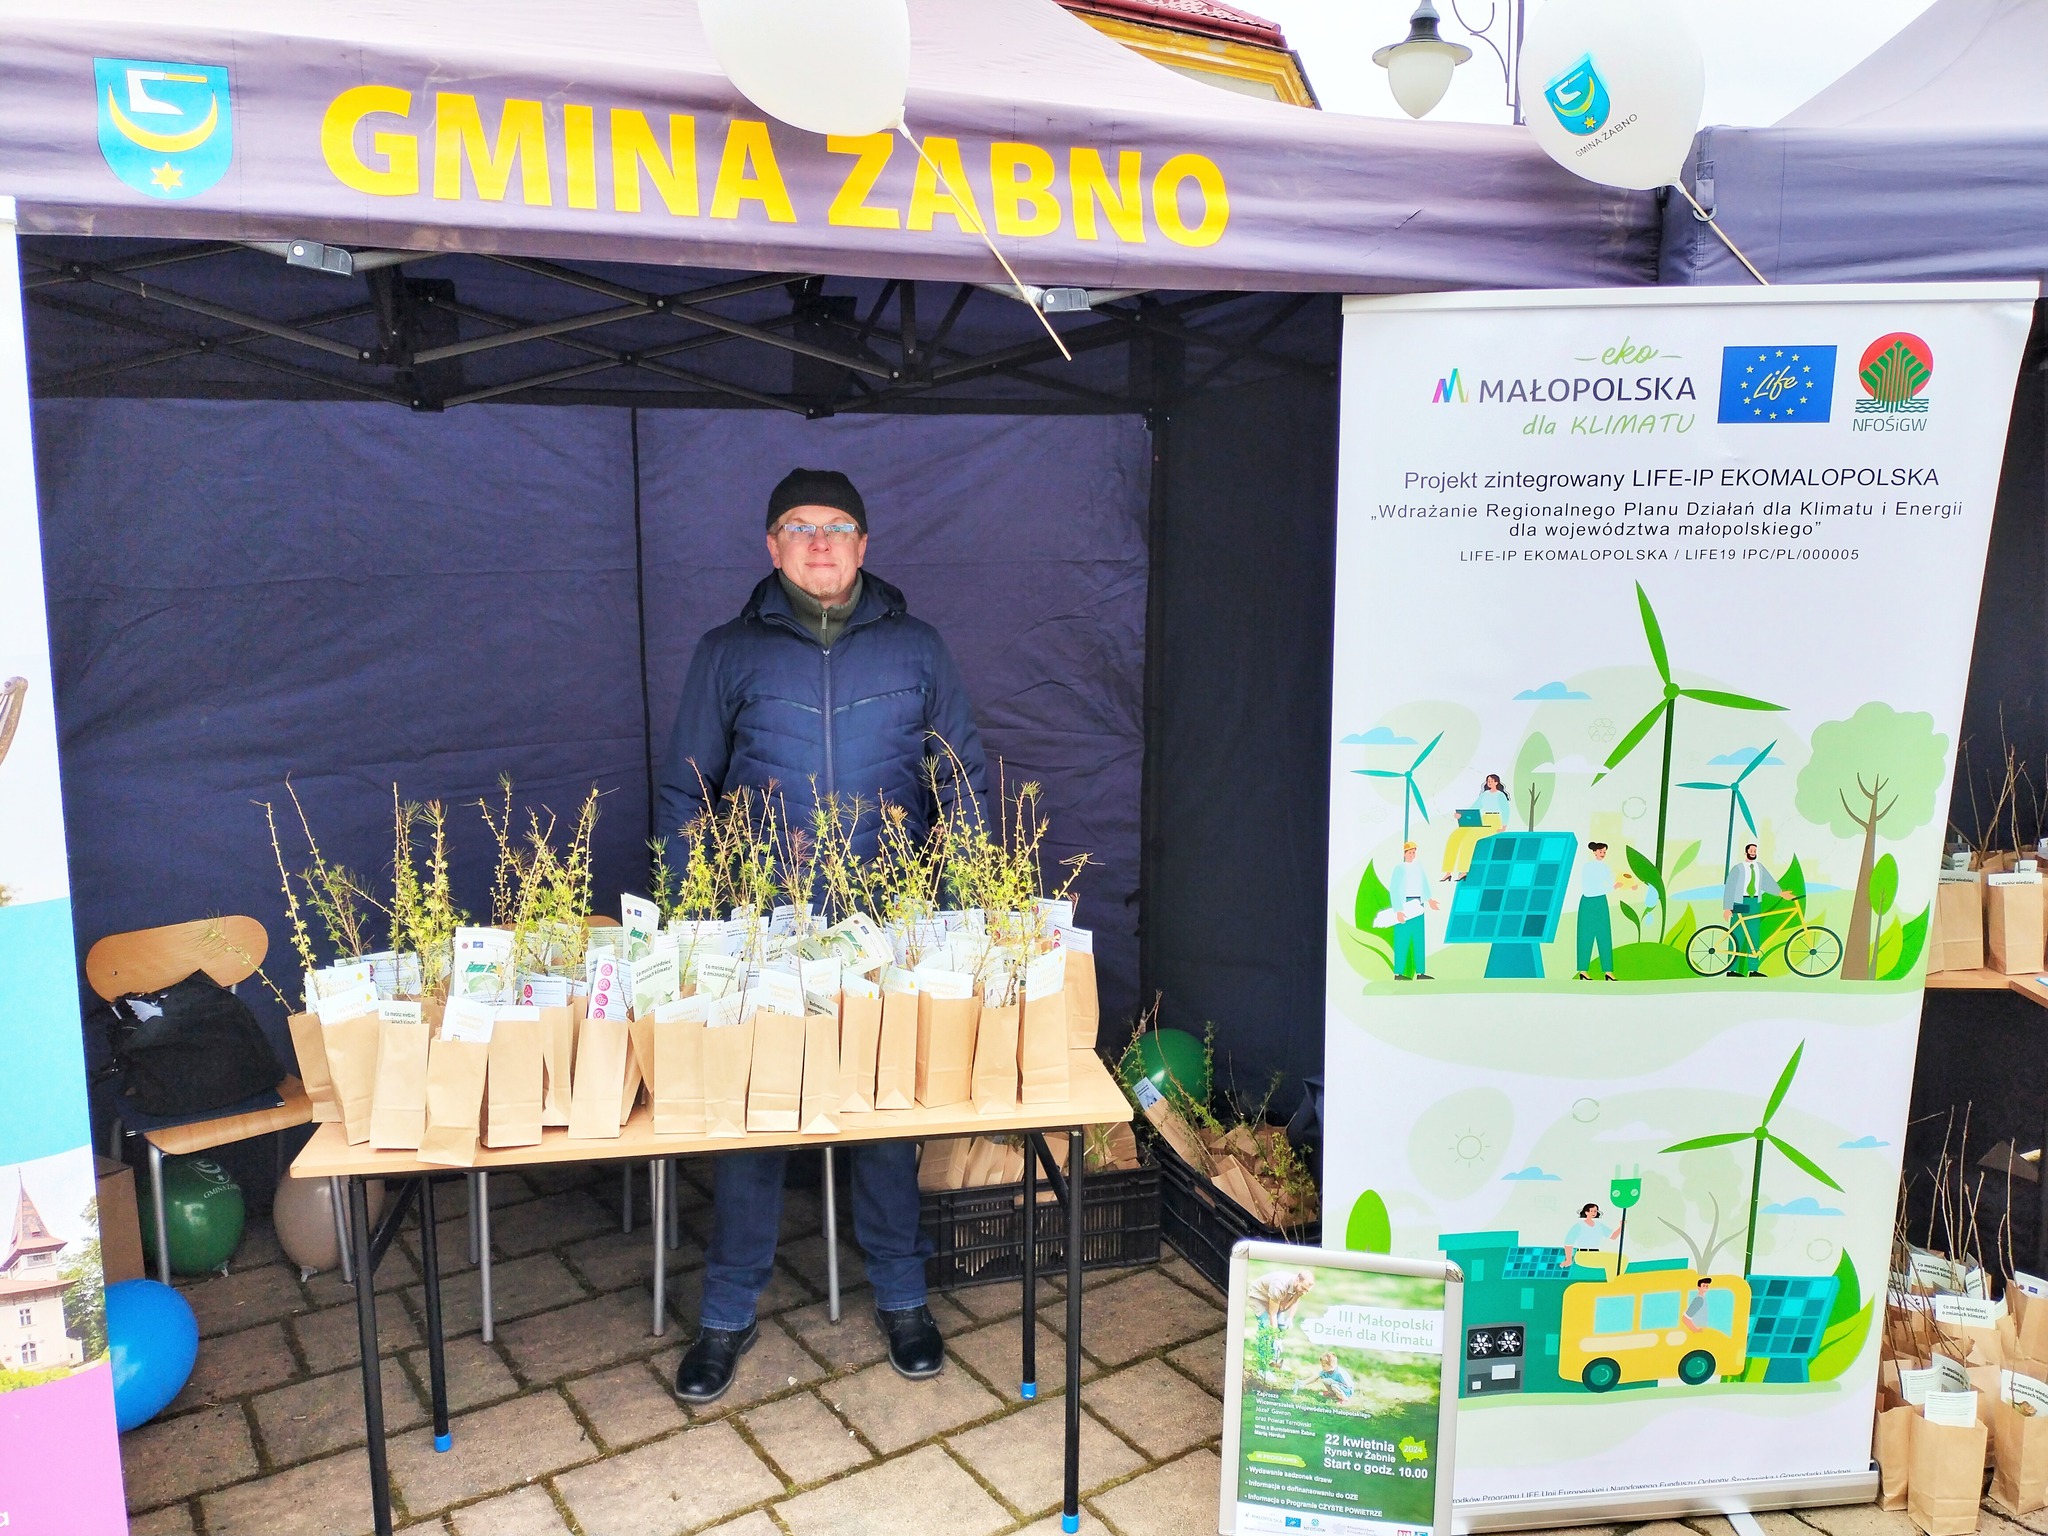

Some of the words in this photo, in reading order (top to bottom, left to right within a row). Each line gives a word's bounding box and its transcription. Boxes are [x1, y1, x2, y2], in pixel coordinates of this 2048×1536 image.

[1575, 138, 1603, 157] GMINA
[1602, 113, 1638, 141] ŻABNO
[320, 83, 797, 223] GMINA
[1601, 336, 1659, 365] eko
[1479, 376, 1697, 403] MAŁOPOLSKA
[1753, 365, 1798, 401] Life
[1523, 414, 1556, 435] dla
[1571, 413, 1696, 435] KLIMATU
[1852, 415, 1928, 432] NFOŚiGW
[1404, 471, 1478, 493] Projekt
[1484, 471, 1625, 492] zintegrowany
[1633, 469, 1714, 487] LIFE-IP
[1721, 468, 1940, 487] EKOMALOPOLSKA
[1371, 503, 1478, 521] „Wdrażanie
[1486, 503, 1616, 520] Regionalnego
[1624, 502, 1678, 516] Planu
[1687, 501, 1755, 516] Działań
[1763, 501, 1791, 515] dla
[1800, 501, 1873, 515] Klimatu
[1881, 501, 1887, 515] i
[1895, 501, 1963, 519] Energii
[1509, 523, 1537, 537] dla
[1545, 522, 1671, 540] województwa
[1678, 521, 1821, 538] małopolskiego”
[1460, 551, 1517, 562] LIFE-IP
[1524, 549, 1668, 561] EKOMALOPOLSKA
[1674, 549, 1680, 560] /
[1685, 549, 1736, 560] LIFE19
[1742, 548, 1860, 560] IPC/PL/000005
[1339, 1310, 1353, 1323] III
[1358, 1312, 1434, 1332] Małopolski
[1314, 1322, 1353, 1338] Dzień
[1356, 1328, 1377, 1342] dla
[1381, 1330, 1433, 1347] Klimatu
[1324, 1433, 1340, 1446] 22
[1343, 1435, 1395, 1453] kwietnia
[1403, 1445, 1423, 1454] 2024
[1324, 1446, 1353, 1458] Rynek
[1364, 1450, 1396, 1463] Żabnie
[1249, 1466, 1283, 1477] Wydawanie
[1284, 1471, 1313, 1481] sadzonek
[1314, 1475, 1333, 1484] drzew
[1323, 1457, 1351, 1470] Start
[1353, 1463, 1361, 1471] o
[1364, 1464, 1395, 1476] godz.
[1399, 1467, 1428, 1479] 10.00
[1248, 1480, 1280, 1491] Informacja
[1287, 1485, 1335, 1498] dofinansowaniu
[1345, 1493, 1359, 1501] OZE
[1248, 1493, 1280, 1504] Informacja
[1286, 1499, 1317, 1509] Programie
[1318, 1503, 1344, 1513] CZYSTE
[1344, 1506, 1383, 1518] POWIETRZE
